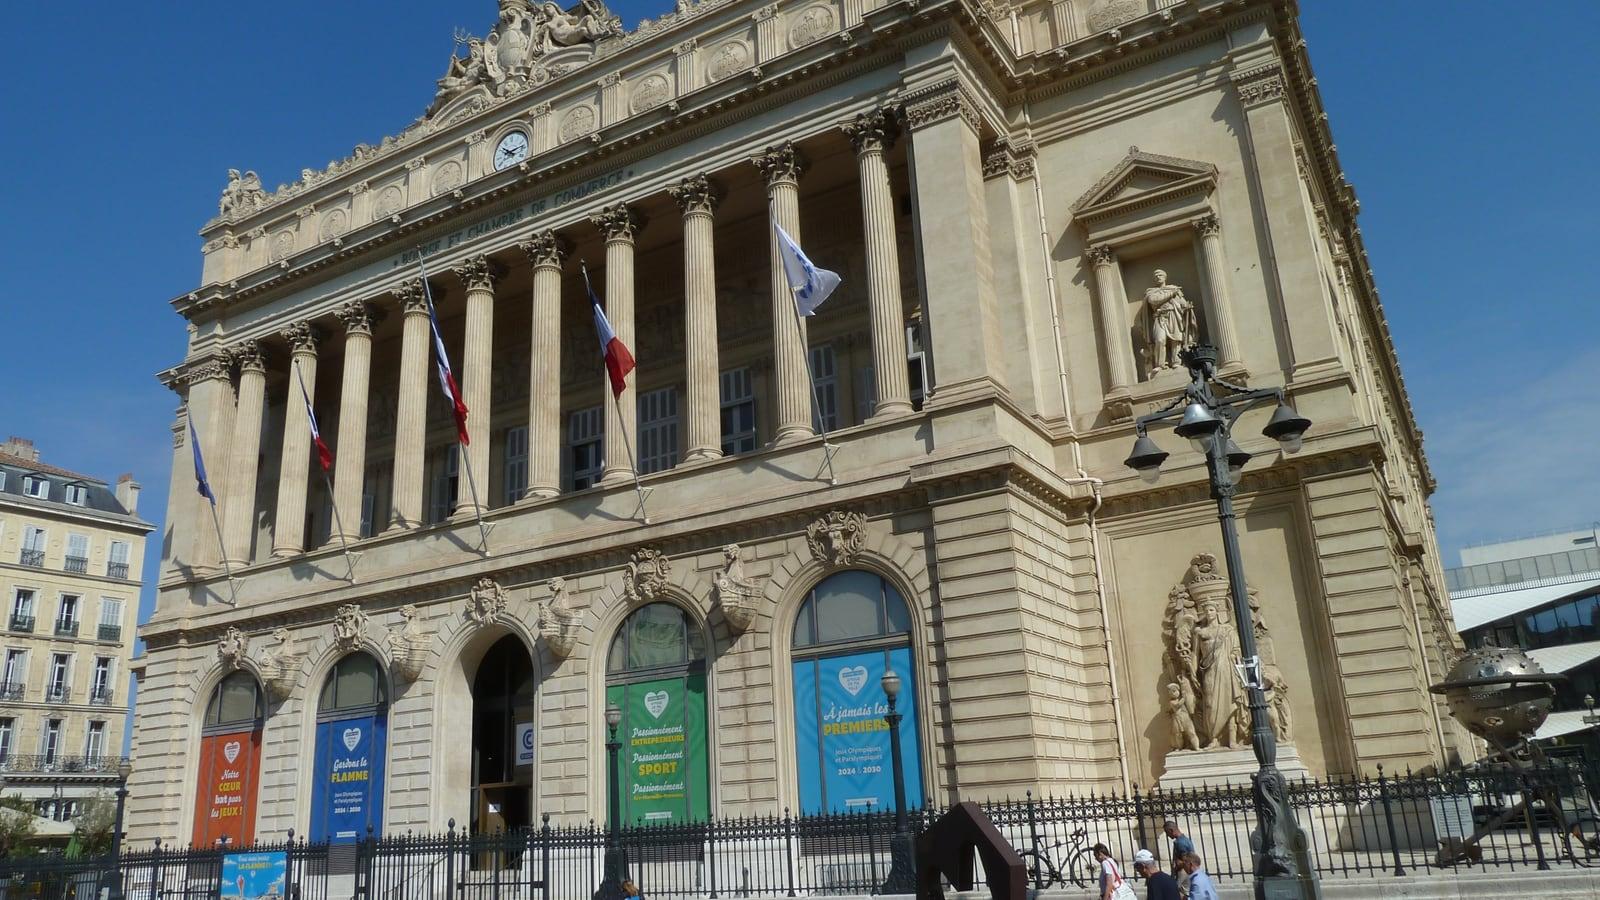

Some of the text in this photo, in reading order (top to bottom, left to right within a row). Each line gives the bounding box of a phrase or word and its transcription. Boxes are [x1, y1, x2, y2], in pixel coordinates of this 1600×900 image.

[448, 231, 463, 249] ET
[468, 207, 524, 239] CHAMBRE
[531, 200, 546, 215] DE
[555, 171, 624, 206] COMMERCE
[836, 704, 872, 722] jamais
[632, 724, 684, 738] Passionnément
[823, 718, 890, 736] PREMIERS
[632, 750, 684, 763] Passionnément
[333, 758, 359, 773] Gardons
[639, 762, 678, 776] SPORT
[838, 767, 856, 775] 2024
[221, 769, 240, 780] Notre
[331, 770, 369, 783] FLAMME
[219, 781, 241, 792] CŒUR
[633, 781, 685, 794] Passionnément
[219, 807, 238, 819] JEUX
